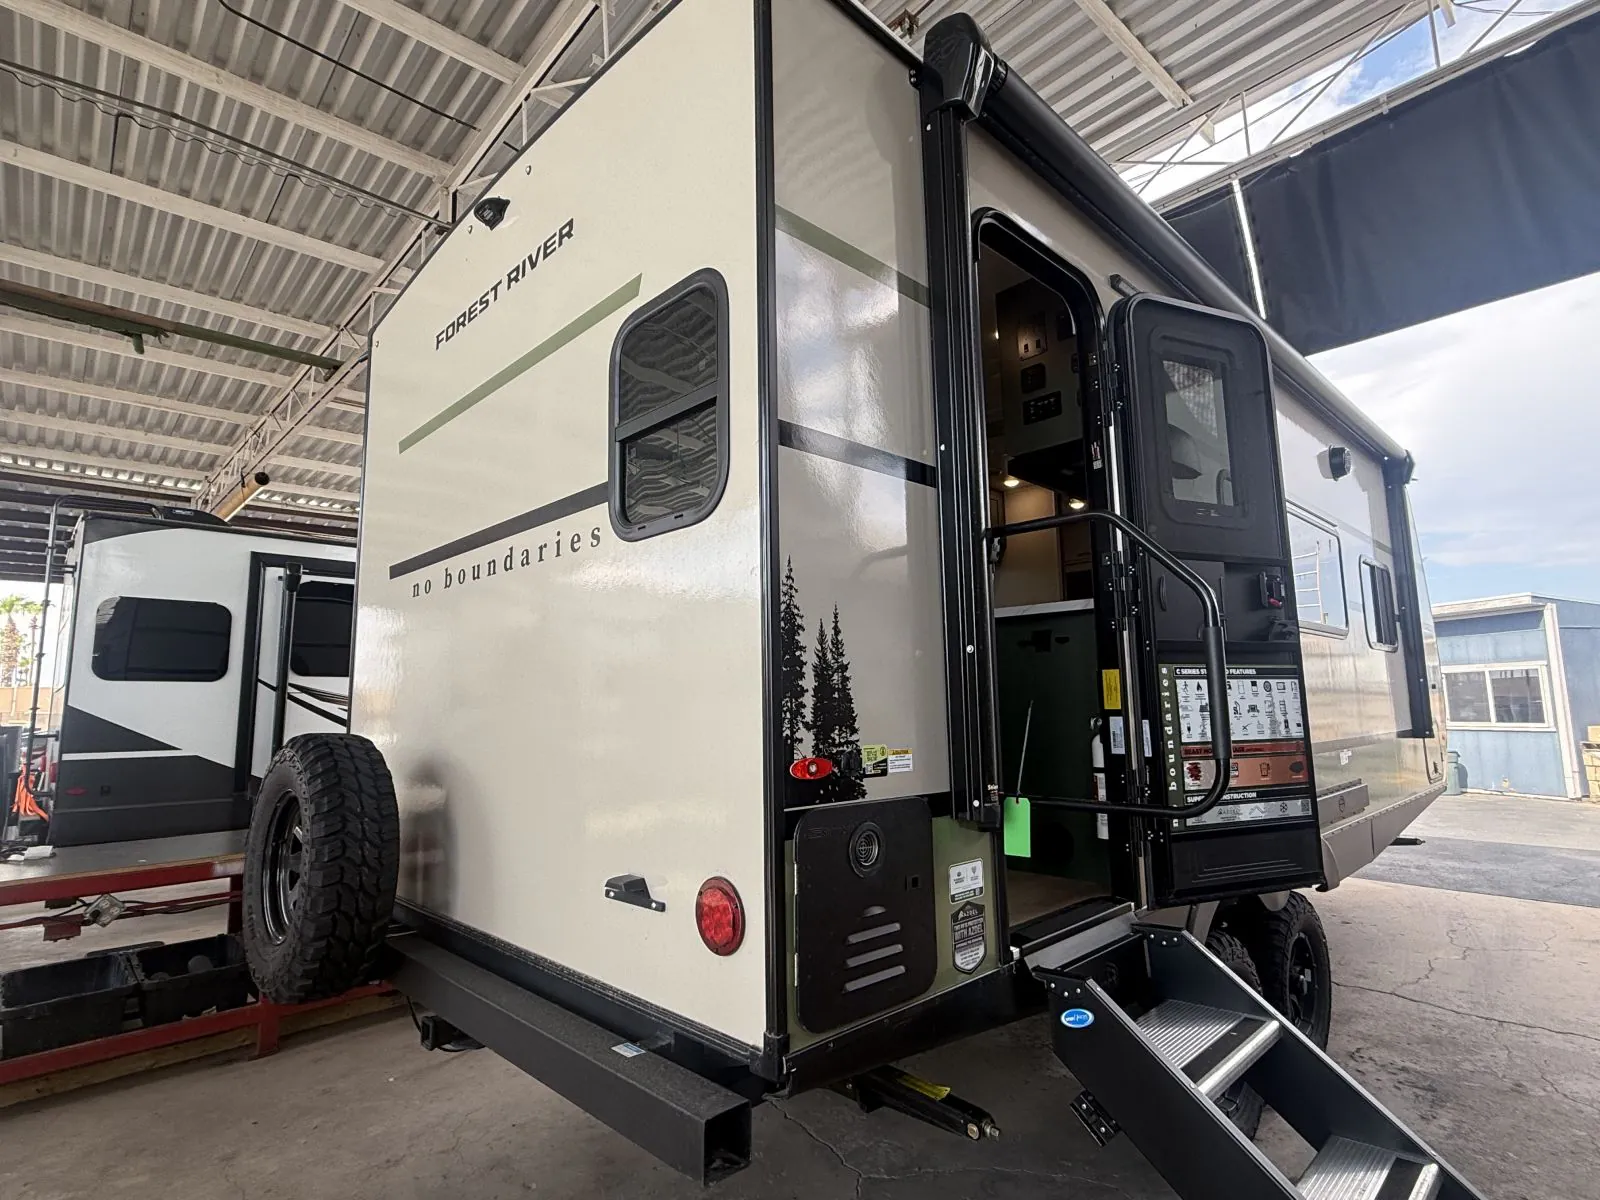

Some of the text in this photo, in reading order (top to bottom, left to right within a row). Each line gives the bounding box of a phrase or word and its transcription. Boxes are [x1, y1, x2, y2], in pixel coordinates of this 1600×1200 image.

[435, 217, 575, 351] FOREST RIVER
[412, 525, 602, 598] no boundaries
[1161, 667, 1178, 791] boundaries
